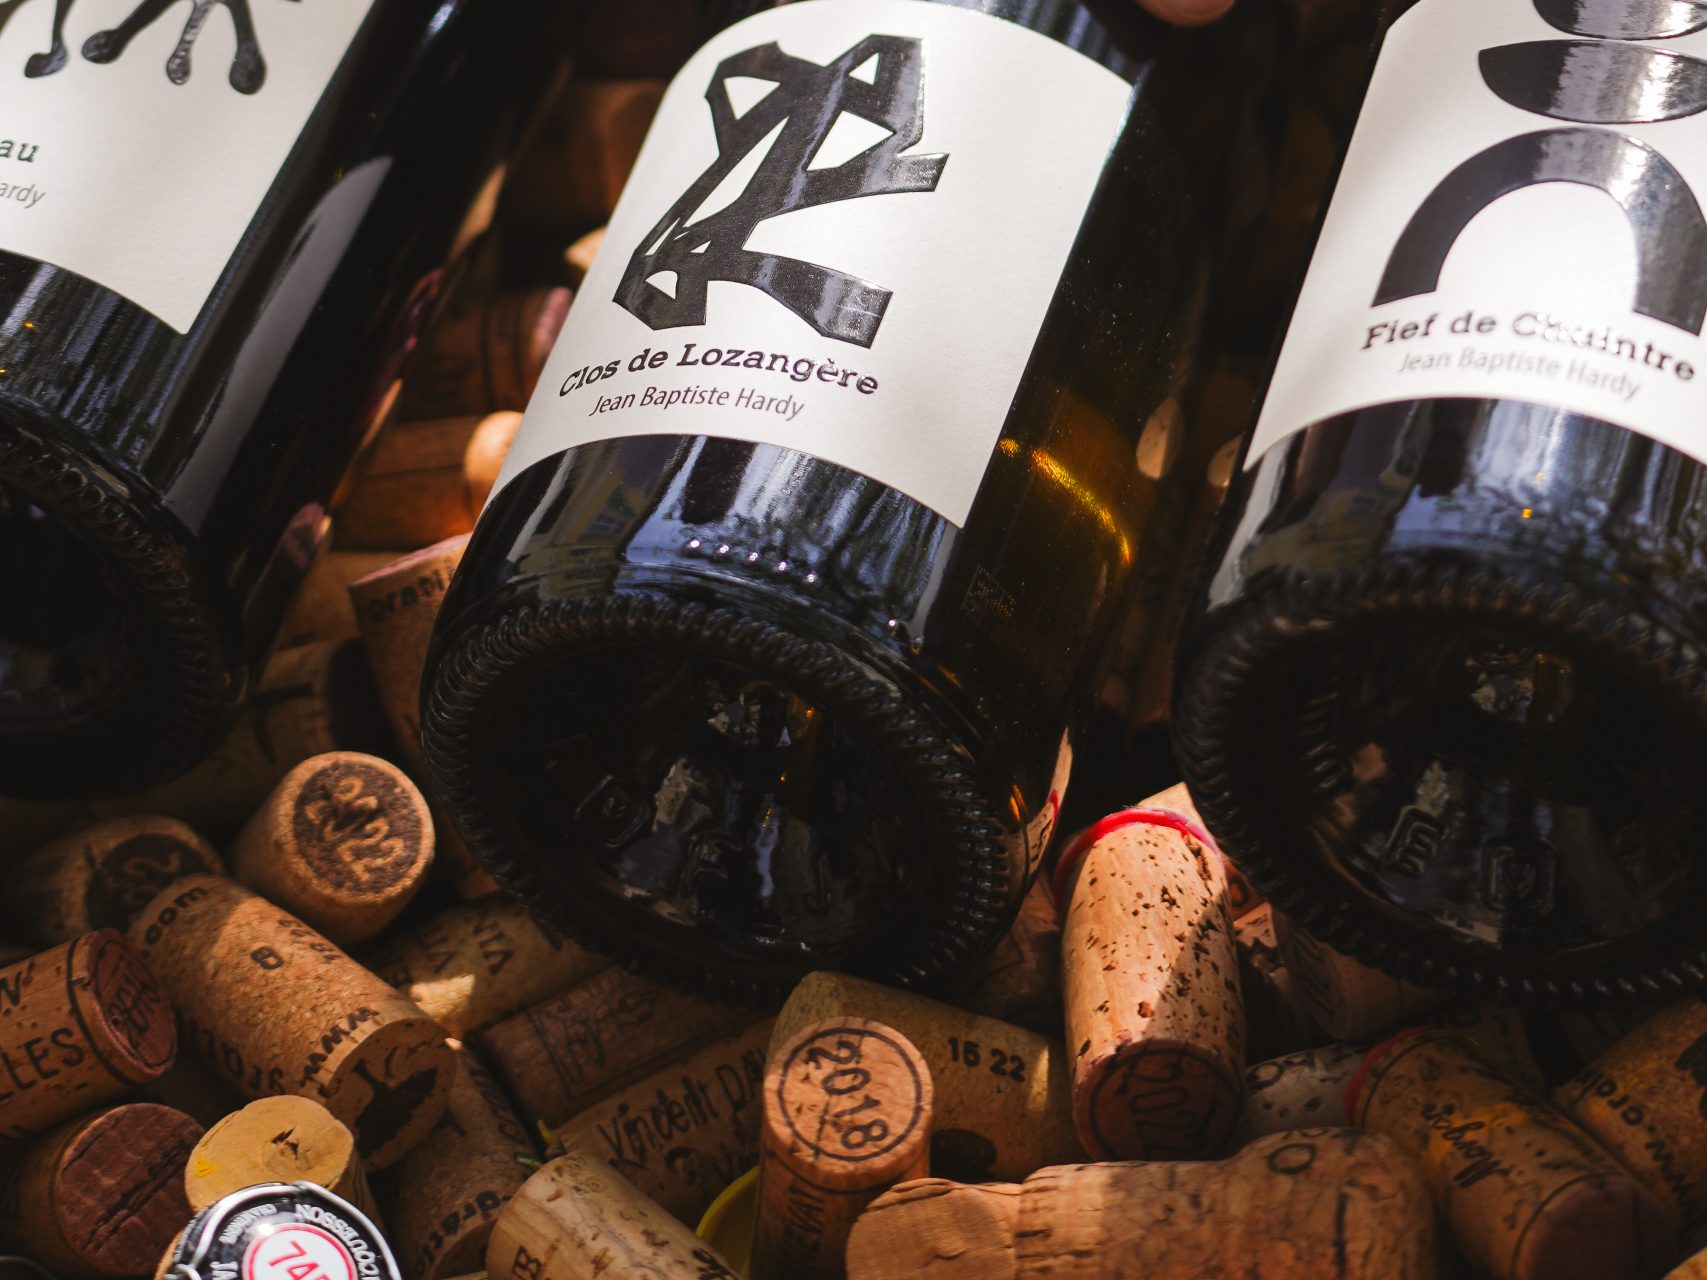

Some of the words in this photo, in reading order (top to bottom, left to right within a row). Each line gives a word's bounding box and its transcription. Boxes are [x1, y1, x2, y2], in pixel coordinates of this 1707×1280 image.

[1361, 312, 1440, 352] Fief
[1450, 311, 1497, 336] de
[559, 361, 617, 397] Clos
[627, 348, 668, 373] de
[677, 343, 878, 395] Lozangère
[1398, 350, 1451, 374] Jean
[1458, 345, 1560, 377] Baptiste
[1564, 360, 1641, 401] Hardy
[589, 391, 635, 417] Jean
[640, 385, 730, 412] Baptiste
[735, 387, 805, 422] Hardy
[803, 1039, 890, 1150] 2018
